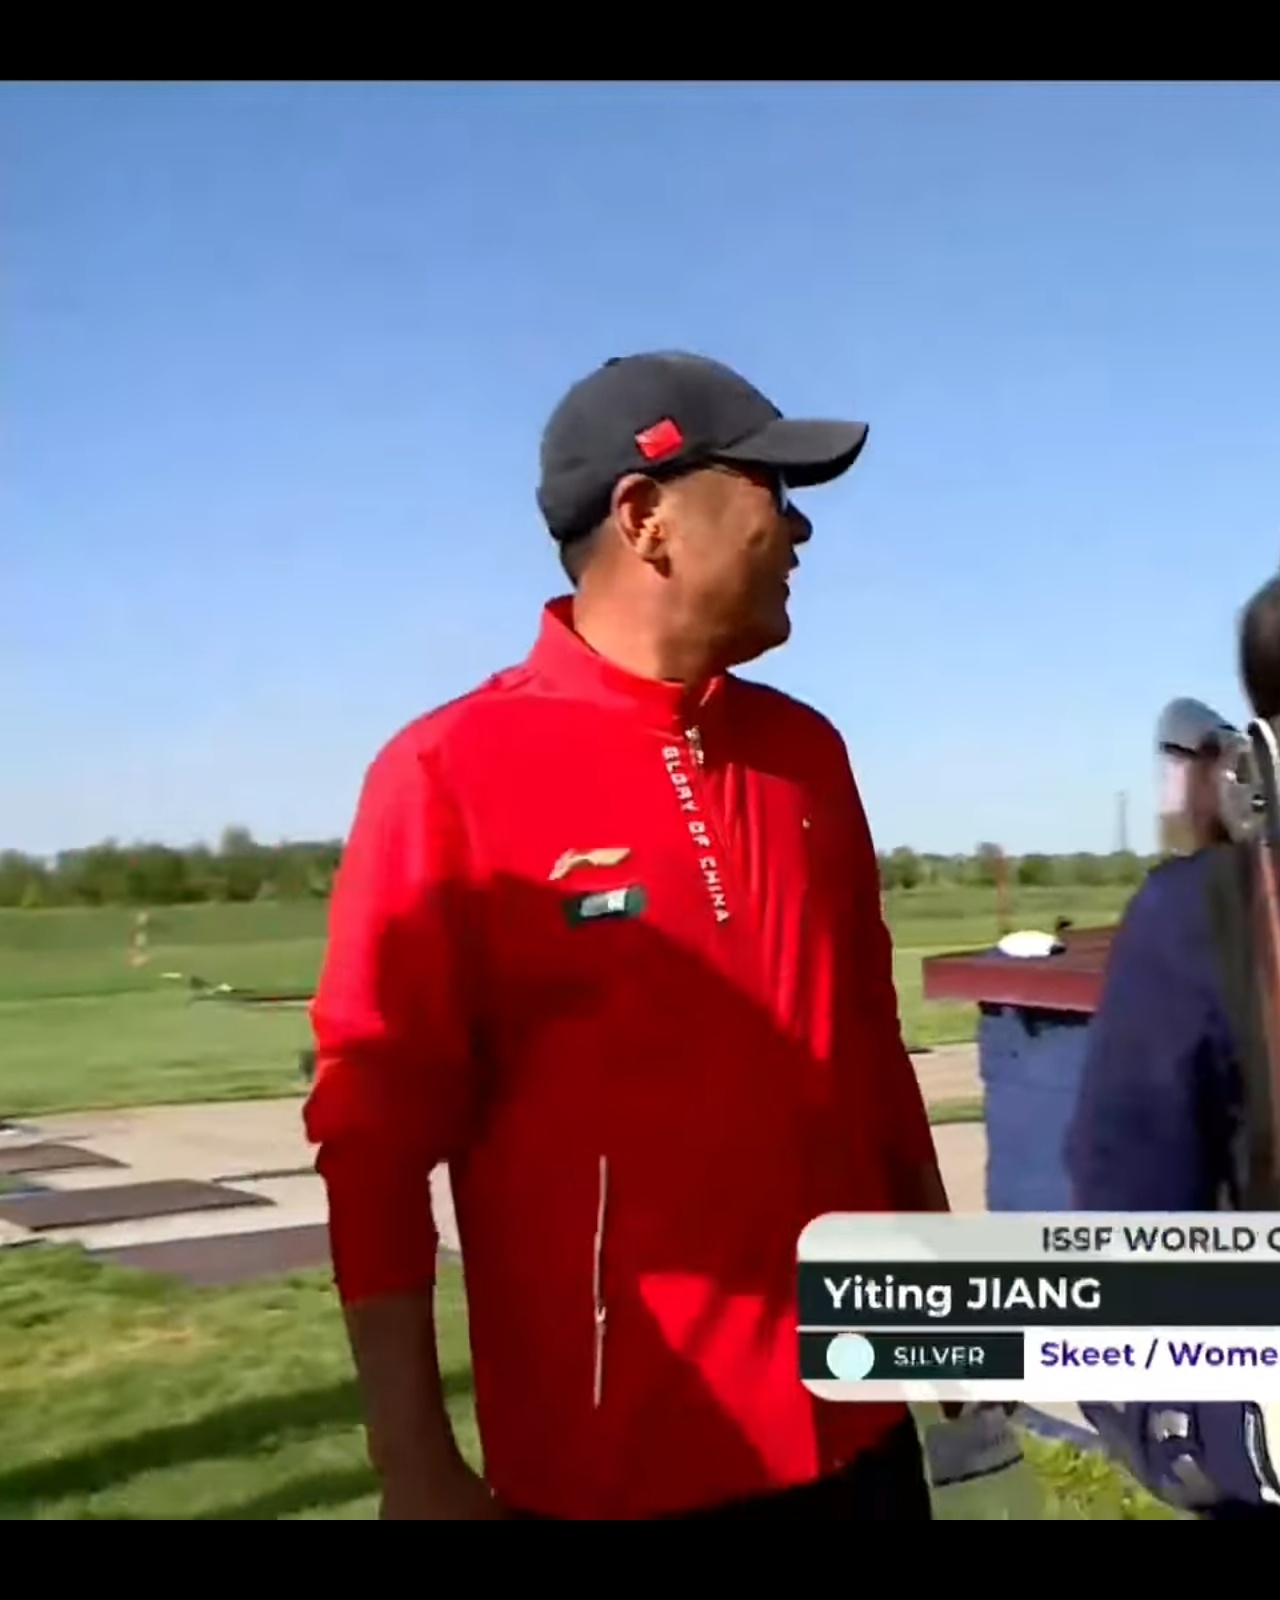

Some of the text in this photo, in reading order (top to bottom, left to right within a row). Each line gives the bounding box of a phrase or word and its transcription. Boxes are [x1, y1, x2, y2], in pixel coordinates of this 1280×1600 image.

[662, 746, 730, 922] GLORY OF CHINA
